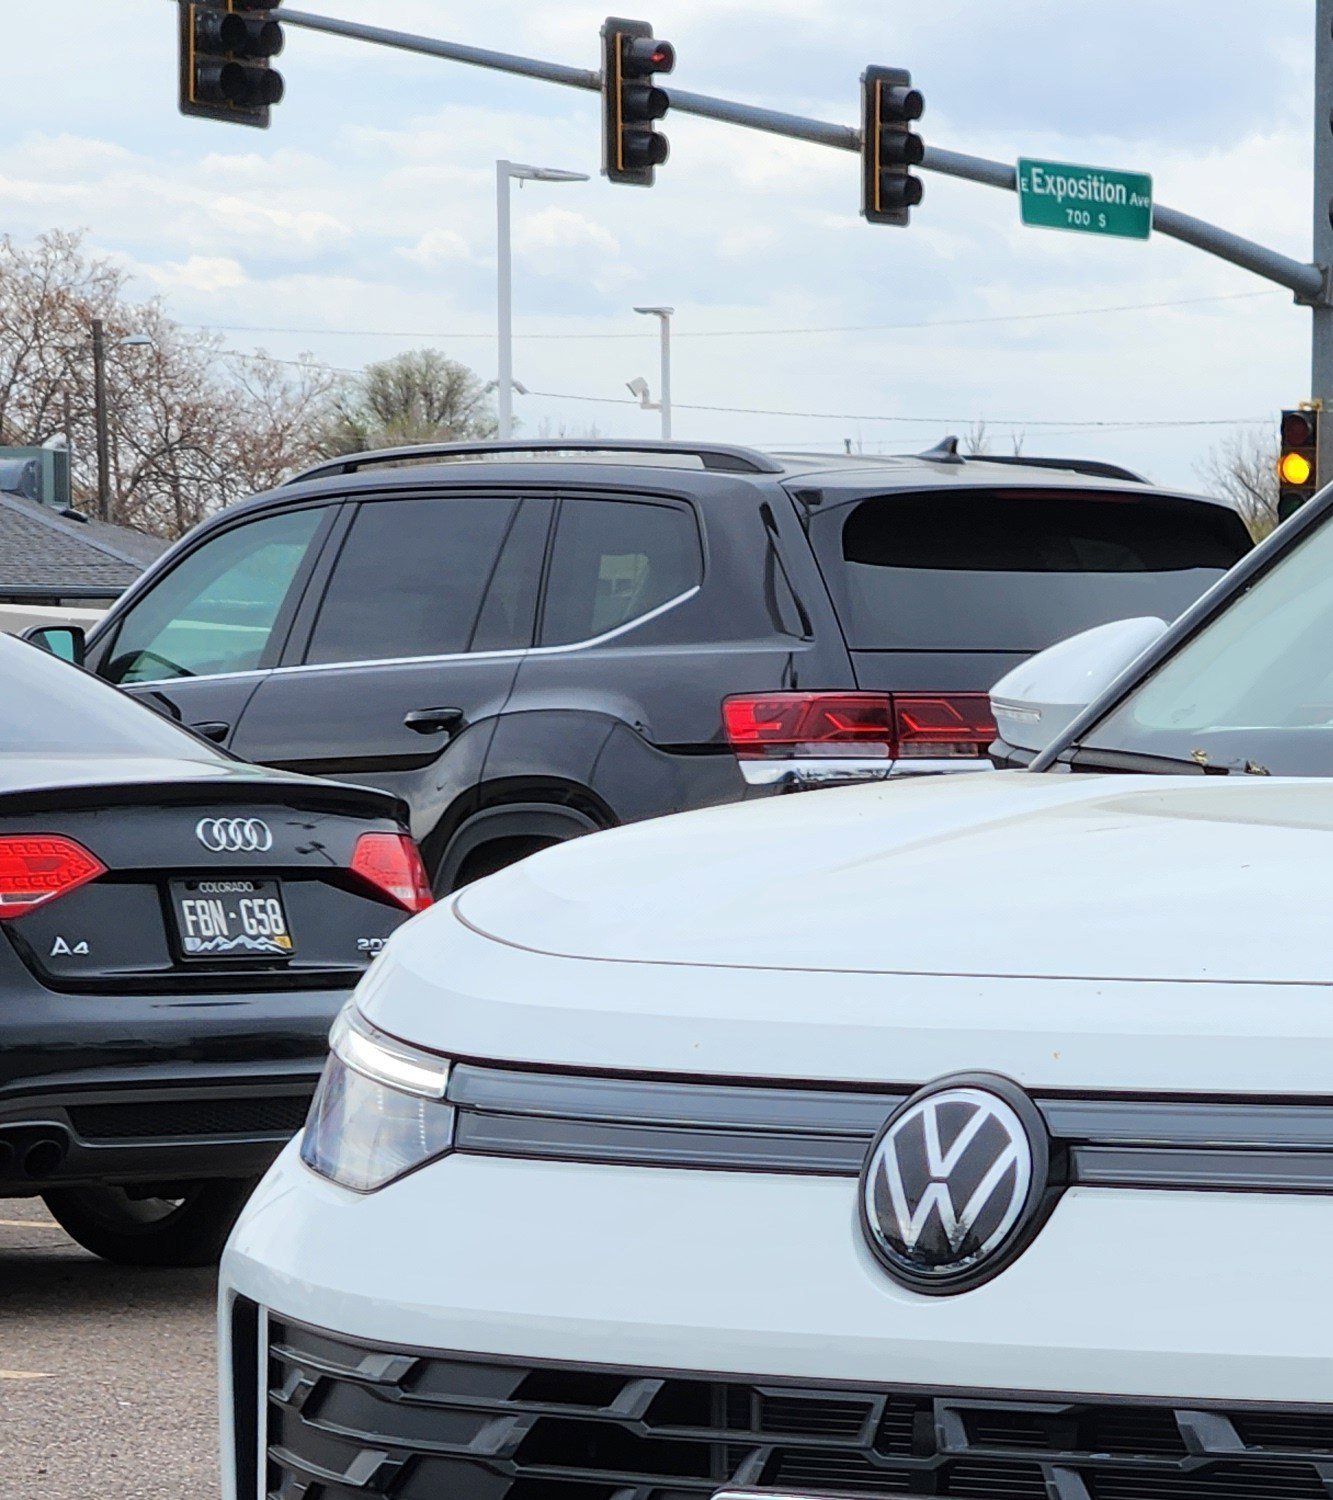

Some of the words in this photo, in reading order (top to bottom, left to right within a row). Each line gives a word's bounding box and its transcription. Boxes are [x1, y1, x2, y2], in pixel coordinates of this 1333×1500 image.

[1021, 178, 1030, 192] E
[1031, 167, 1127, 204] Exposition
[1129, 192, 1149, 207] Ave
[1065, 209, 1090, 226] 700
[1098, 213, 1106, 228] S
[199, 882, 255, 893] COLORADO
[50, 936, 90, 956] A4
[872, 1094, 1026, 1264] VW
